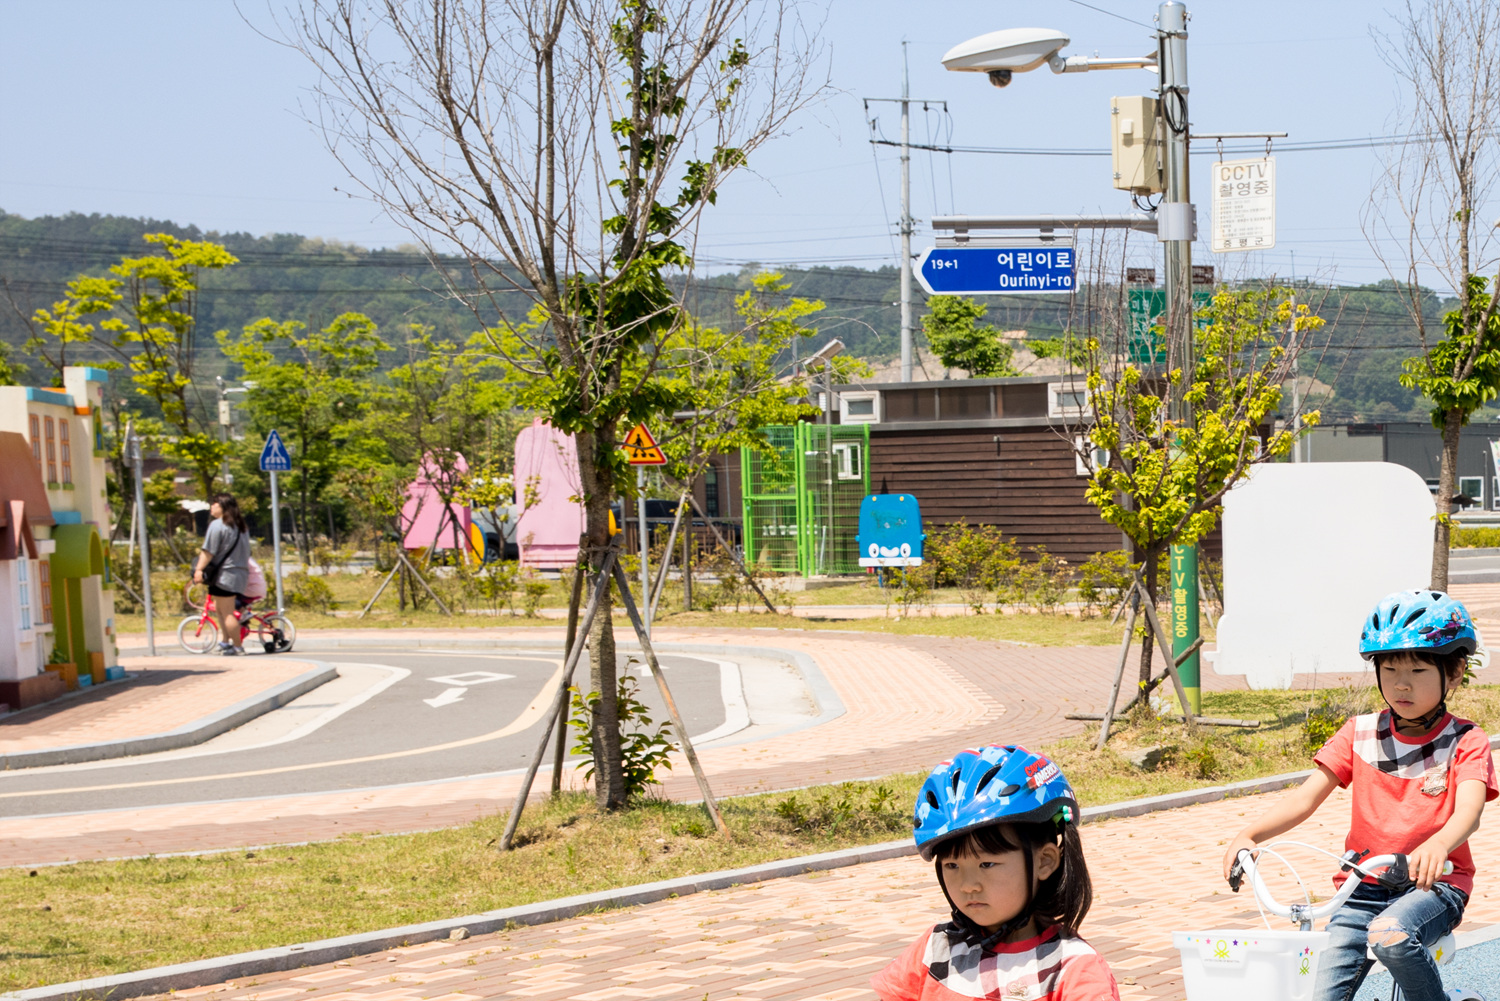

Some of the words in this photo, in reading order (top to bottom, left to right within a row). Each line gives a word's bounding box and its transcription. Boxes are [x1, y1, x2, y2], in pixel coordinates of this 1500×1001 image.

[1220, 163, 1267, 181] CCTV
[997, 252, 1072, 271] 어린이로
[999, 273, 1072, 290] Ourinyi-ro
